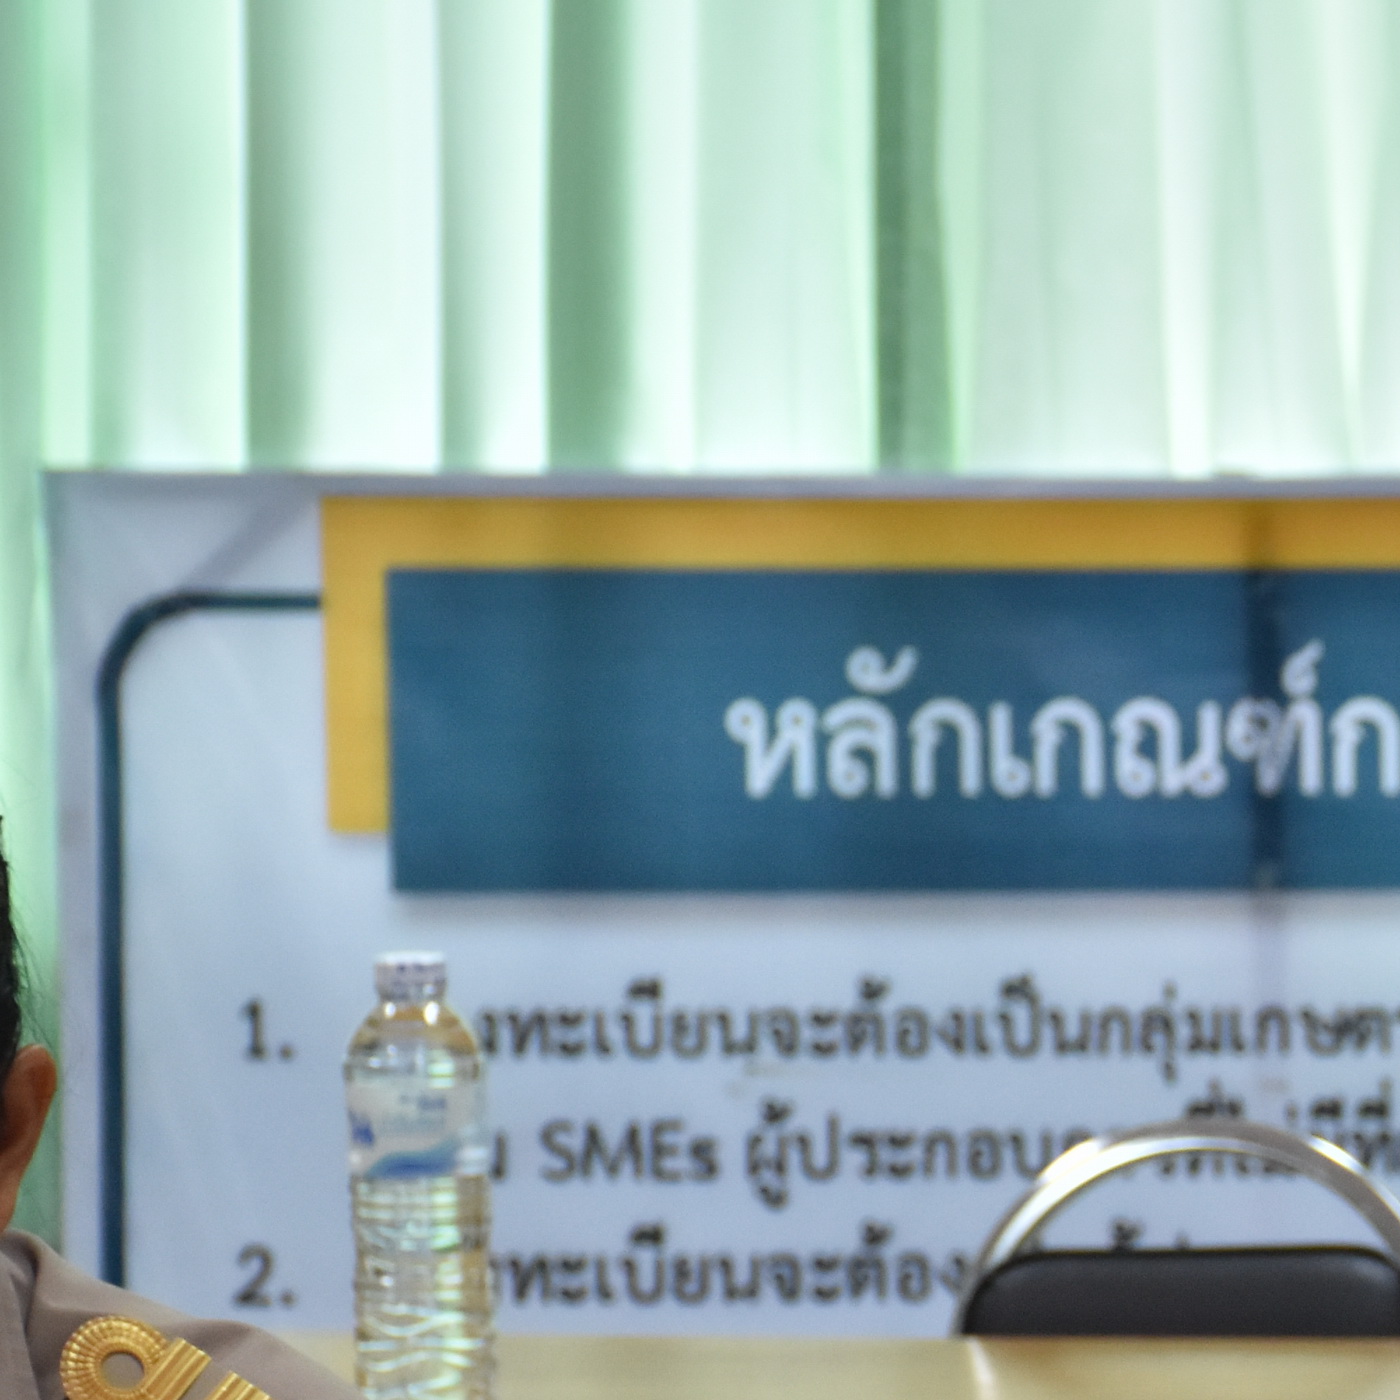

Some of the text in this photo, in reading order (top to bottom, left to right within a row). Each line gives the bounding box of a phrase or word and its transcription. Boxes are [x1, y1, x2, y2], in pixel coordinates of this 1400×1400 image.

[243, 1000, 295, 1062] 1.
[541, 1118, 719, 1184] SMEs
[233, 1243, 296, 1306] 2.
